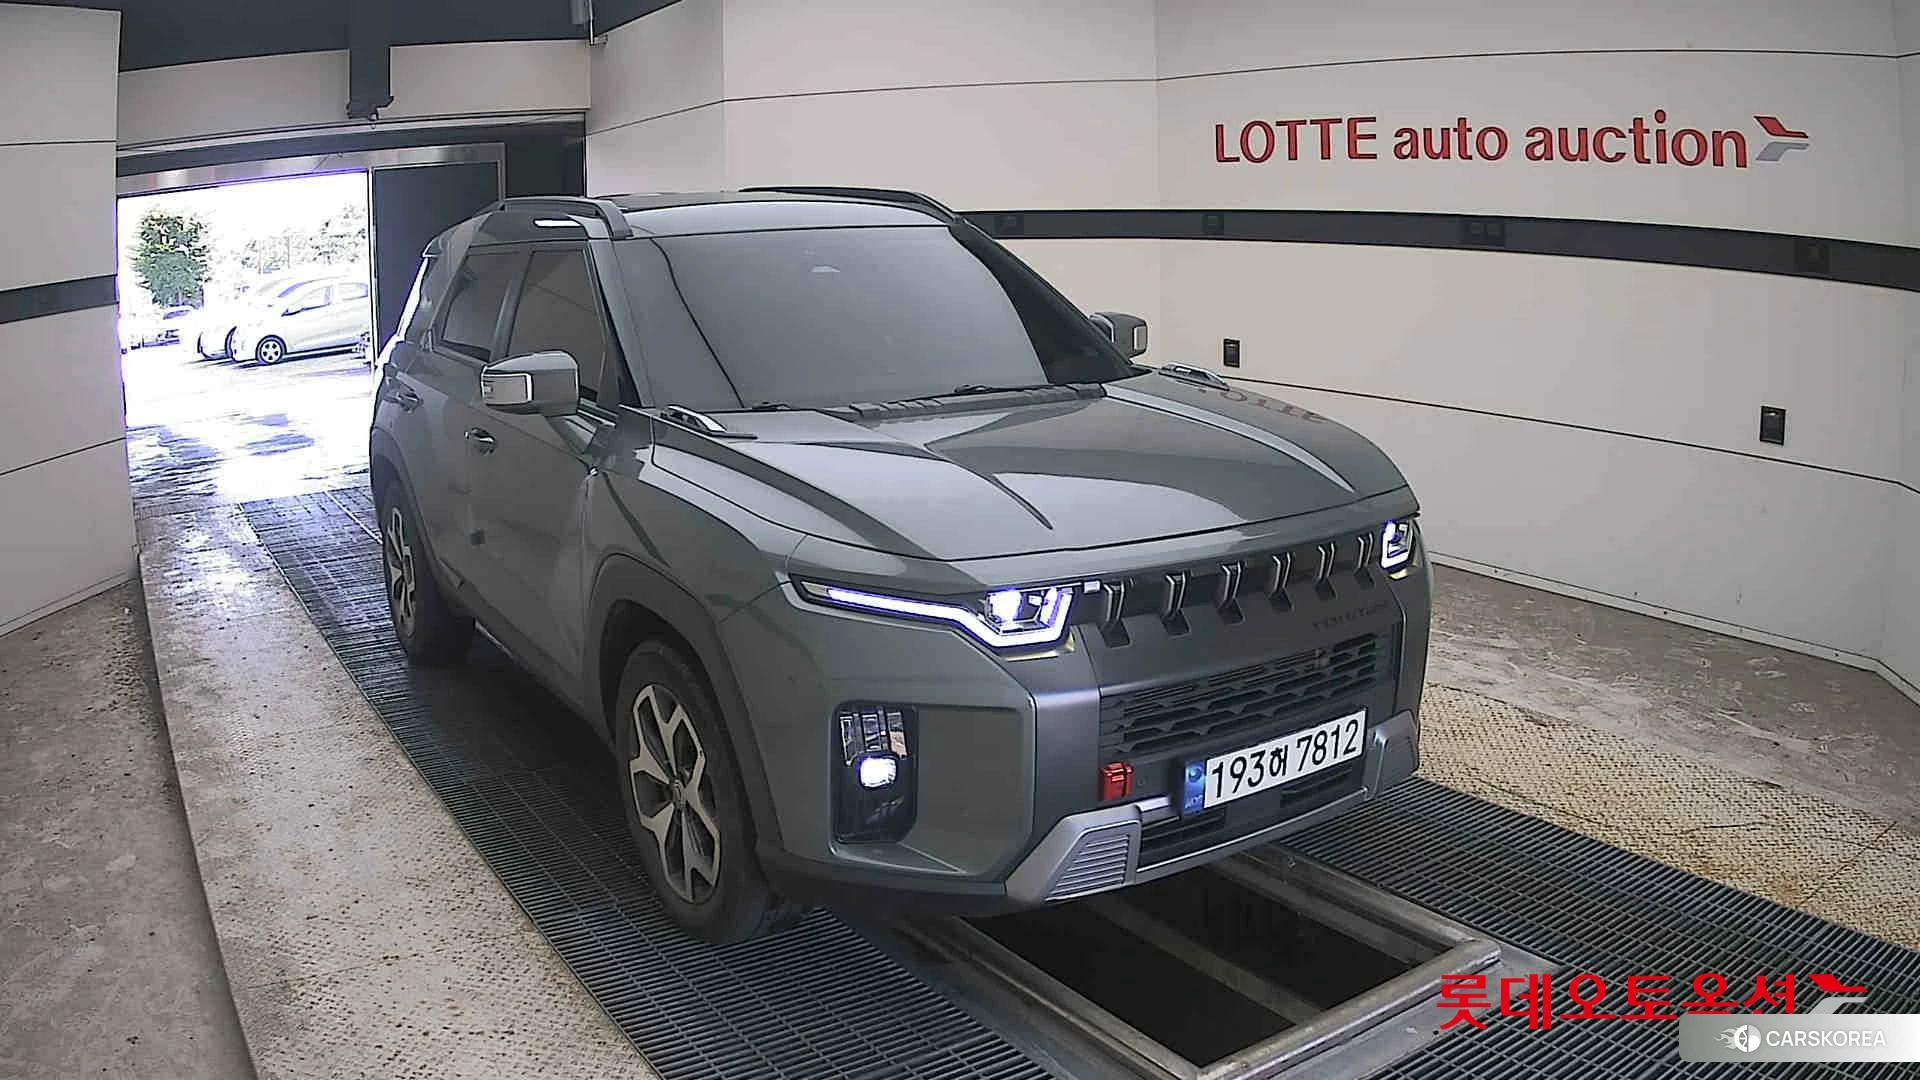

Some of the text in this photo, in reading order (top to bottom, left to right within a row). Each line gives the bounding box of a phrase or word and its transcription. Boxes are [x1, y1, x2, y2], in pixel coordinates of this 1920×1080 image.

[1215, 110, 1749, 168] LOTTE auto auction
[1212, 719, 1359, 798] 193허 7812
